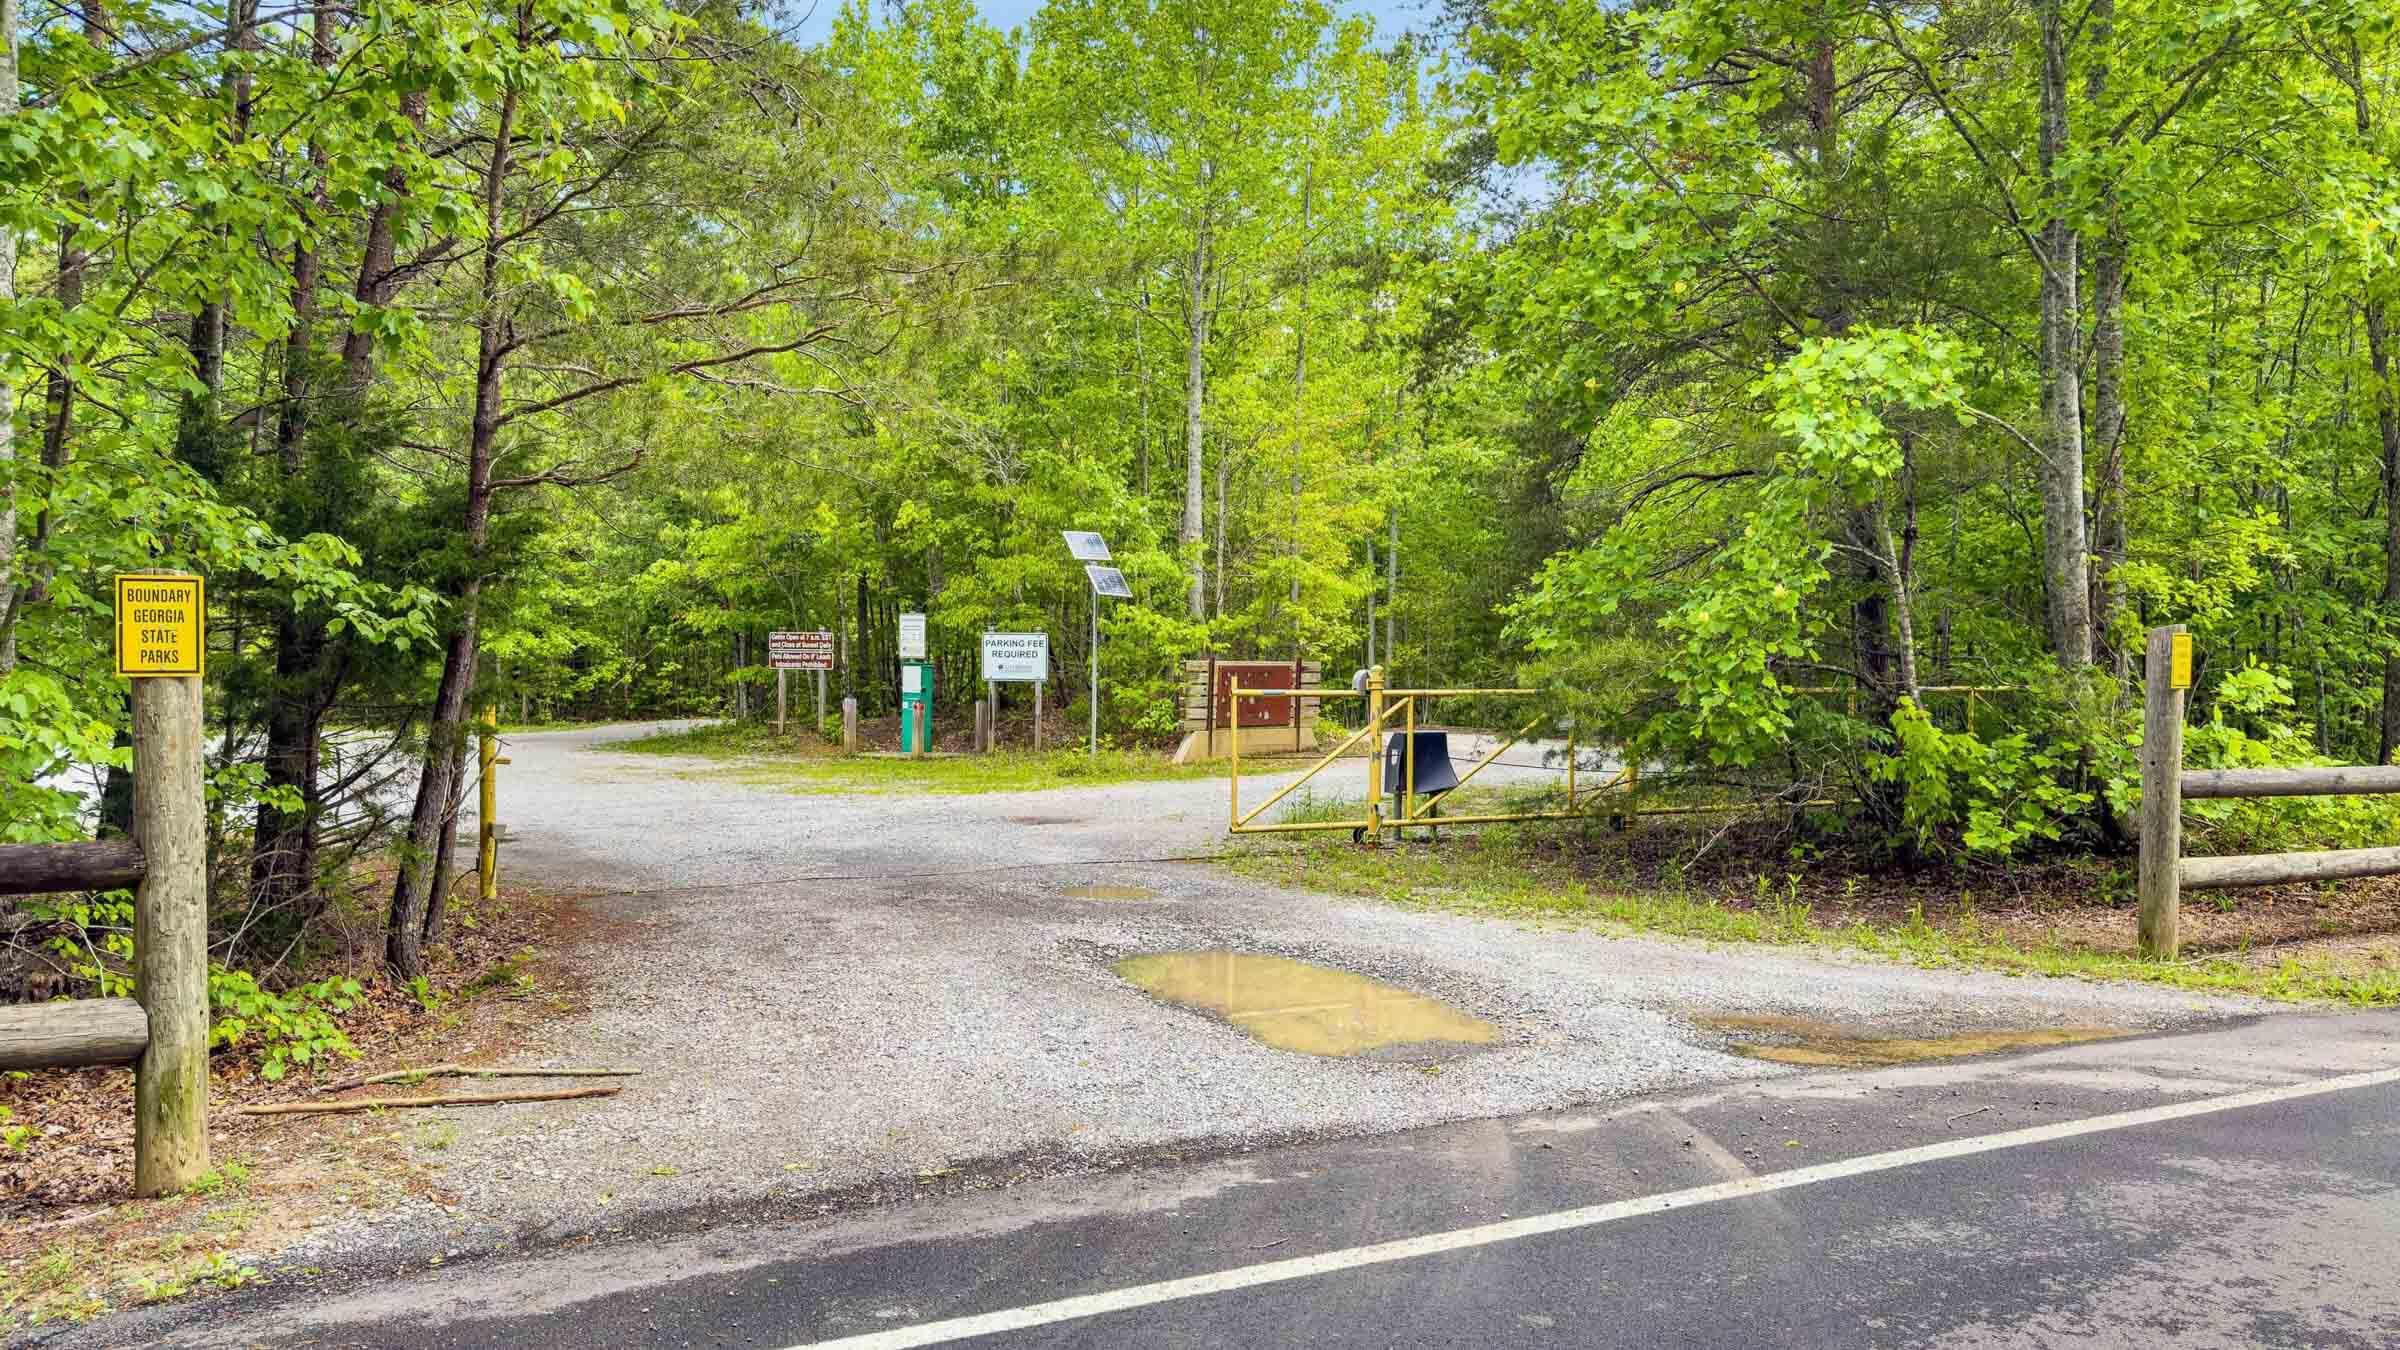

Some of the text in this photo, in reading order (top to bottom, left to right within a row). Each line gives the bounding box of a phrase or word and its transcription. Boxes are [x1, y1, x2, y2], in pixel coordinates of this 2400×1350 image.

[127, 588, 191, 603] BOUNDARY
[134, 609, 184, 623] GEORGIA
[141, 629, 177, 644] STATE
[985, 639, 1045, 648] PARKING FEE
[140, 649, 179, 664] PARKS
[991, 650, 1038, 658] REQUIRED
